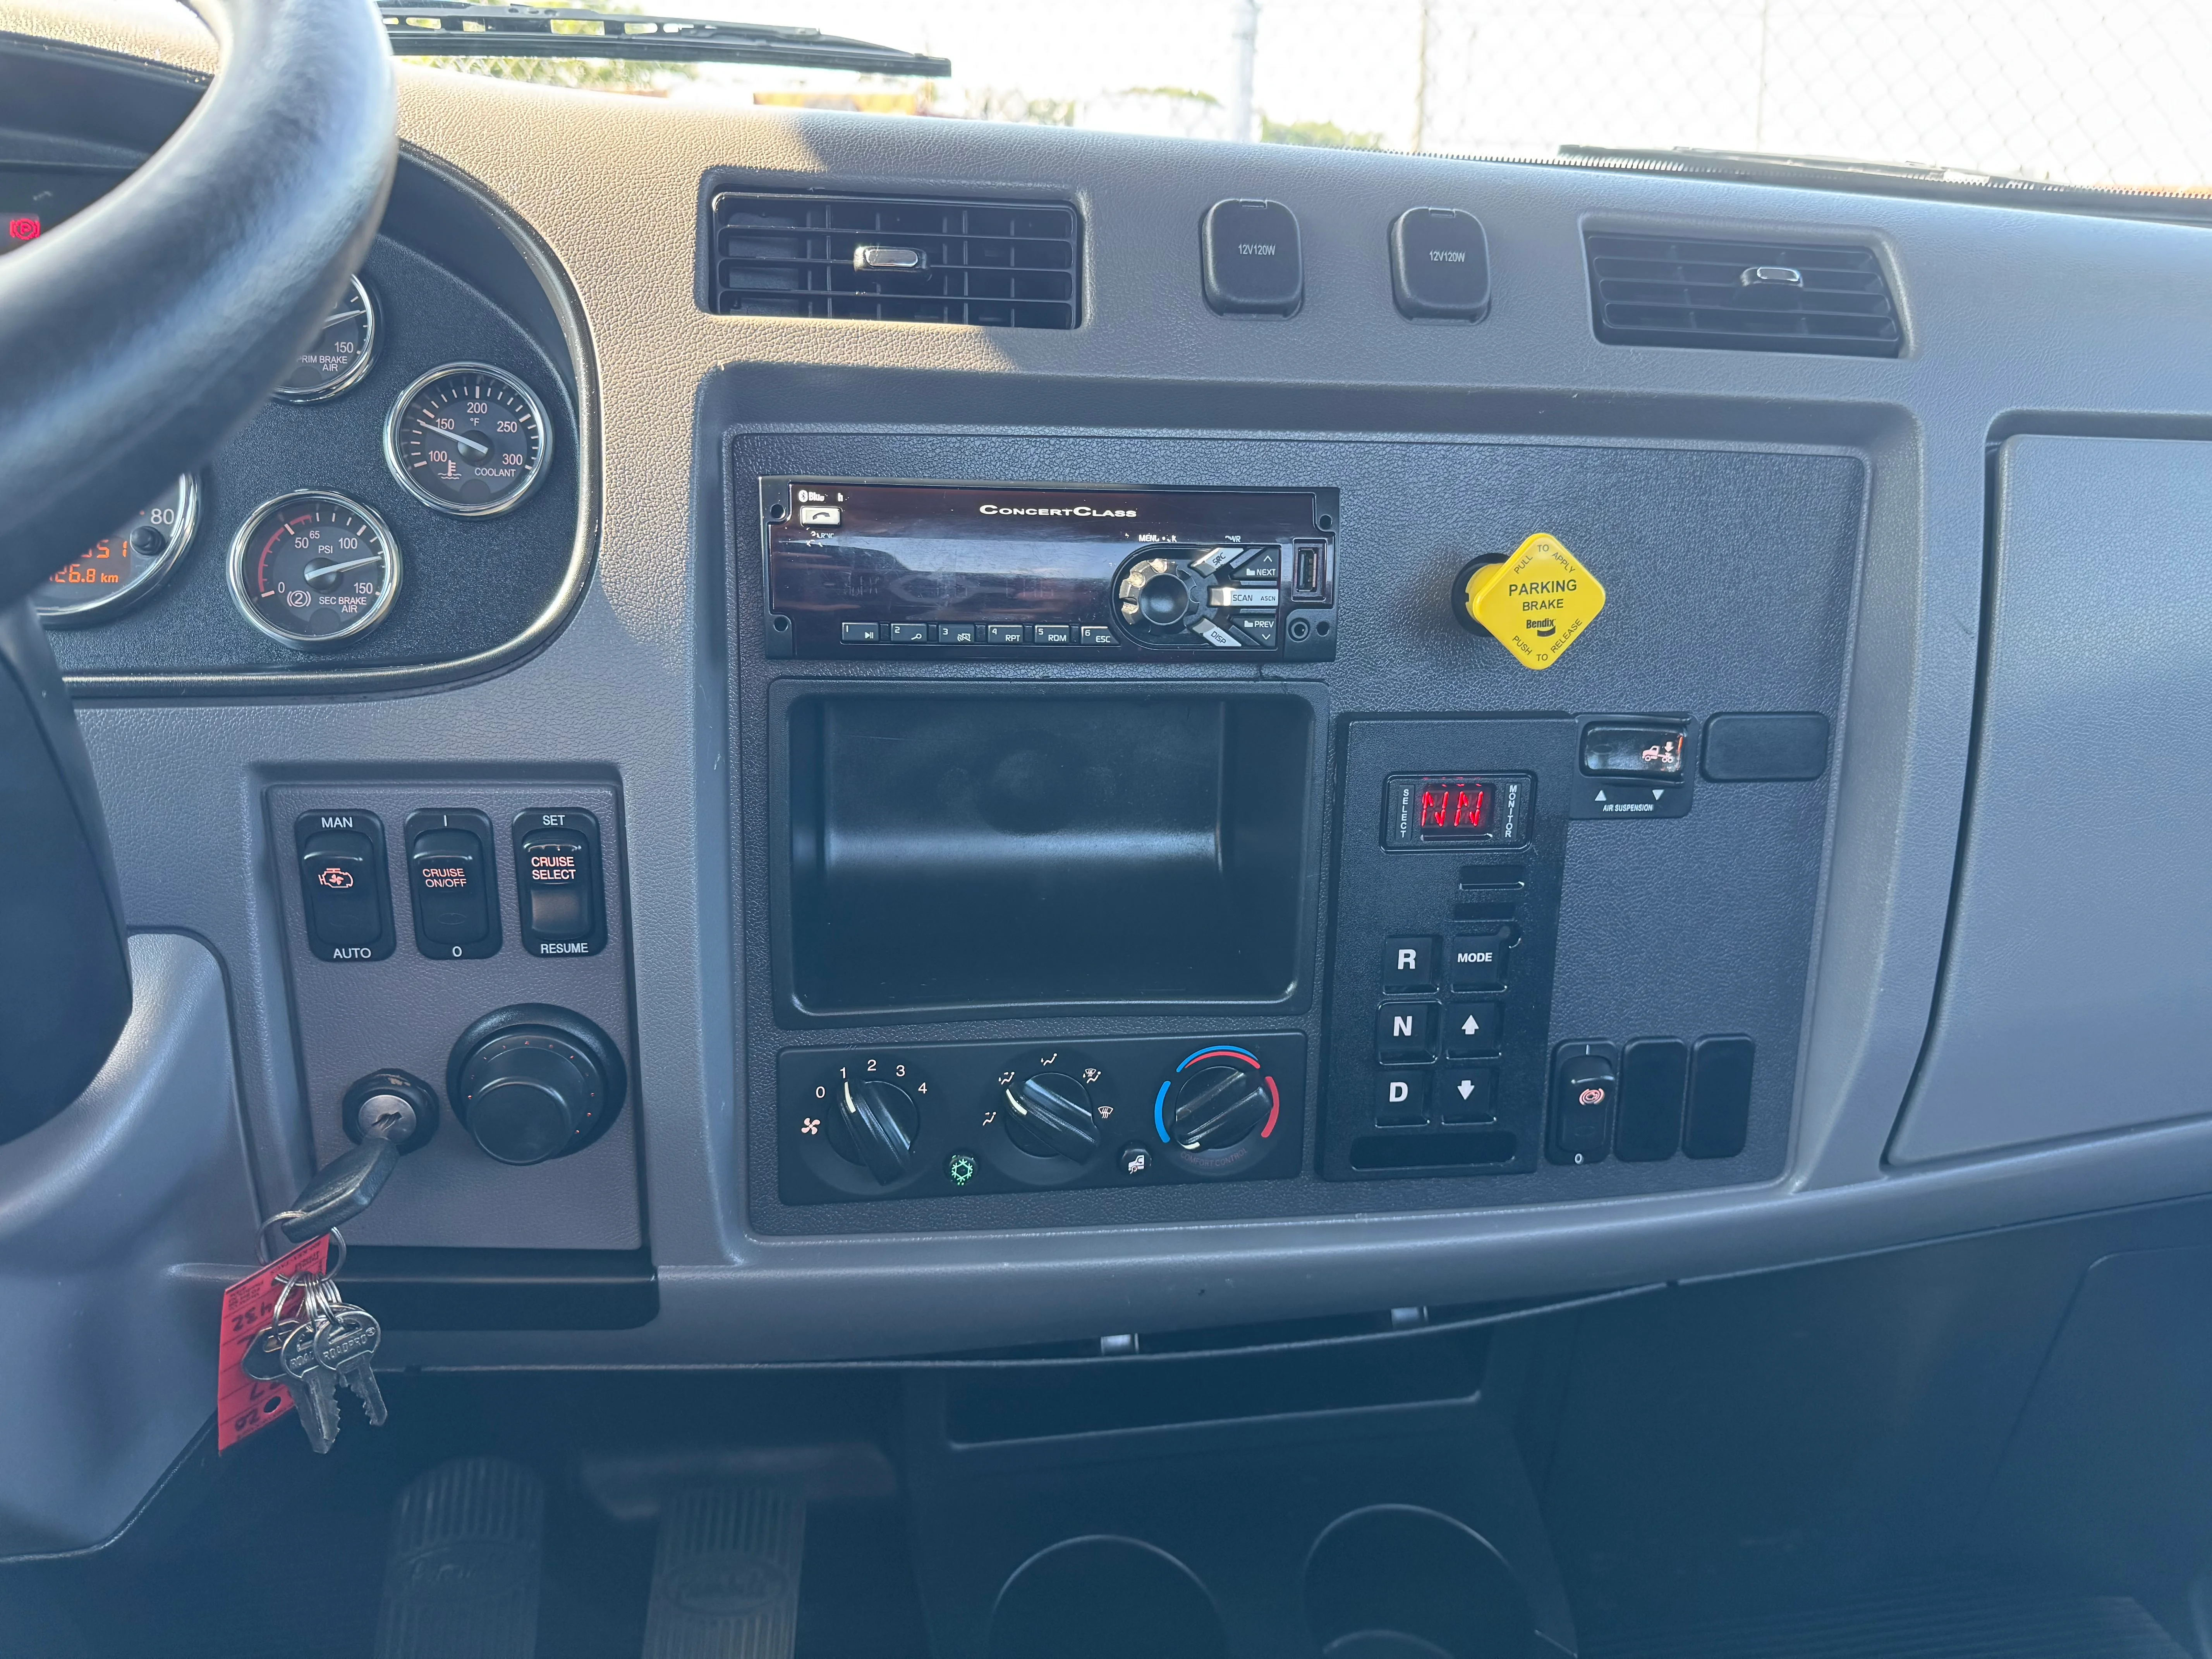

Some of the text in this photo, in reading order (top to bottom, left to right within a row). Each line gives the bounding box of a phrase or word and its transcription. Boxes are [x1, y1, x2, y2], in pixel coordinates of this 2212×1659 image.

[1238, 244, 1276, 256] 12V120W
[1429, 250, 1466, 263] 12V120W
[335, 342, 354, 353] 150
[467, 402, 488, 414] 200
[436, 419, 455, 430] 150
[497, 421, 517, 433] 250
[429, 451, 447, 462] 100
[503, 454, 523, 465] 300
[475, 467, 516, 477] COOLANT
[151, 508, 174, 525] 80
[310, 531, 320, 539] 65
[295, 538, 309, 549] 50
[338, 538, 358, 549] 100
[318, 546, 333, 554] PSI
[1212, 552, 1226, 566] SRC
[1514, 555, 1533, 574] PULL
[1552, 552, 1575, 574] APPLY
[101, 573, 118, 583] km
[278, 582, 285, 593] 0
[354, 583, 373, 594] 150
[1509, 579, 1577, 596] PARKING
[1522, 599, 1564, 611] BRAKE
[1526, 618, 1554, 629] Bendix
[1210, 631, 1226, 644] DISP
[1512, 635, 1532, 655] PUSH
[1550, 618, 1582, 653] RELEASE
[1400, 789, 1409, 838] SELECT
[1505, 785, 1517, 837] MONITOR
[321, 817, 353, 828] MAN
[543, 815, 565, 826] SET
[531, 857, 575, 867] CRUISE
[422, 868, 465, 878] CRUISE
[532, 869, 576, 880] SELECT
[425, 878, 467, 888] ON/OFF
[333, 948, 371, 958] AUTO
[541, 943, 589, 953] RESUME
[1398, 949, 1416, 970] R
[1457, 952, 1492, 963] MODE
[1393, 1016, 1412, 1036] N
[867, 1059, 877, 1071] 2
[896, 1065, 905, 1076] 3
[840, 1067, 846, 1078] 1
[816, 1086, 825, 1098] 0
[918, 1083, 927, 1094] 4
[1389, 1082, 1408, 1103] D
[1180, 1148, 1248, 1167] COMFORT CONTROL
